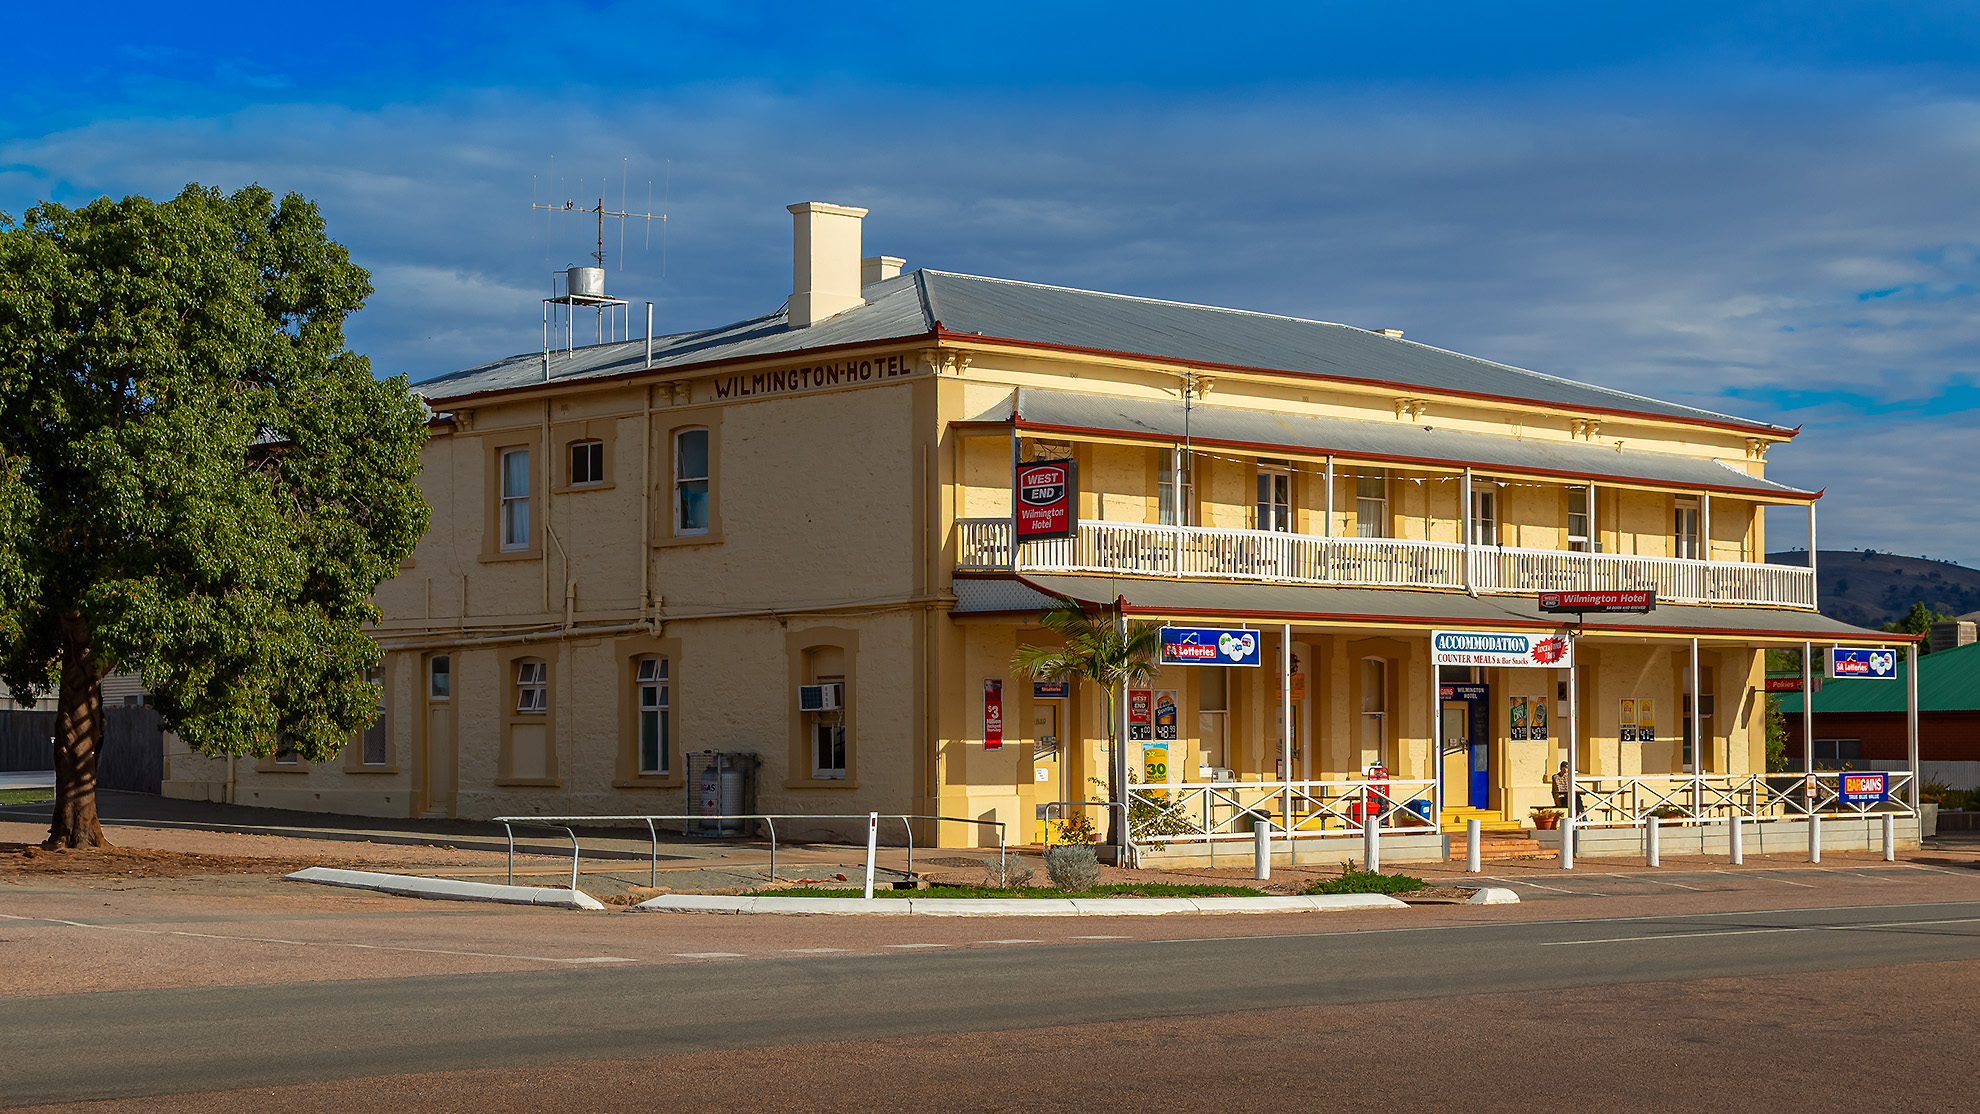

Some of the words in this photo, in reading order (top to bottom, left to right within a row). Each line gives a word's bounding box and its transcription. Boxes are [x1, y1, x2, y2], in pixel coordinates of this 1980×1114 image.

[1028, 472, 1058, 484] WEST
[1032, 488, 1054, 500] END
[1022, 508, 1064, 519] Wilmington
[1032, 519, 1051, 529] Hotel
[1564, 595, 1617, 605] Wilmington
[1620, 593, 1646, 602] Hotel
[1438, 635, 1526, 652] ACCOMMODATION
[1180, 646, 1214, 656] Lotteries
[1438, 654, 1471, 664] COUNTER
[1474, 655, 1496, 664] MEALS
[1512, 657, 1528, 665] Snacks
[1845, 663, 1867, 671] Lotteries
[988, 705, 999, 719] $3
[1846, 778, 1882, 792] BARGAINS
